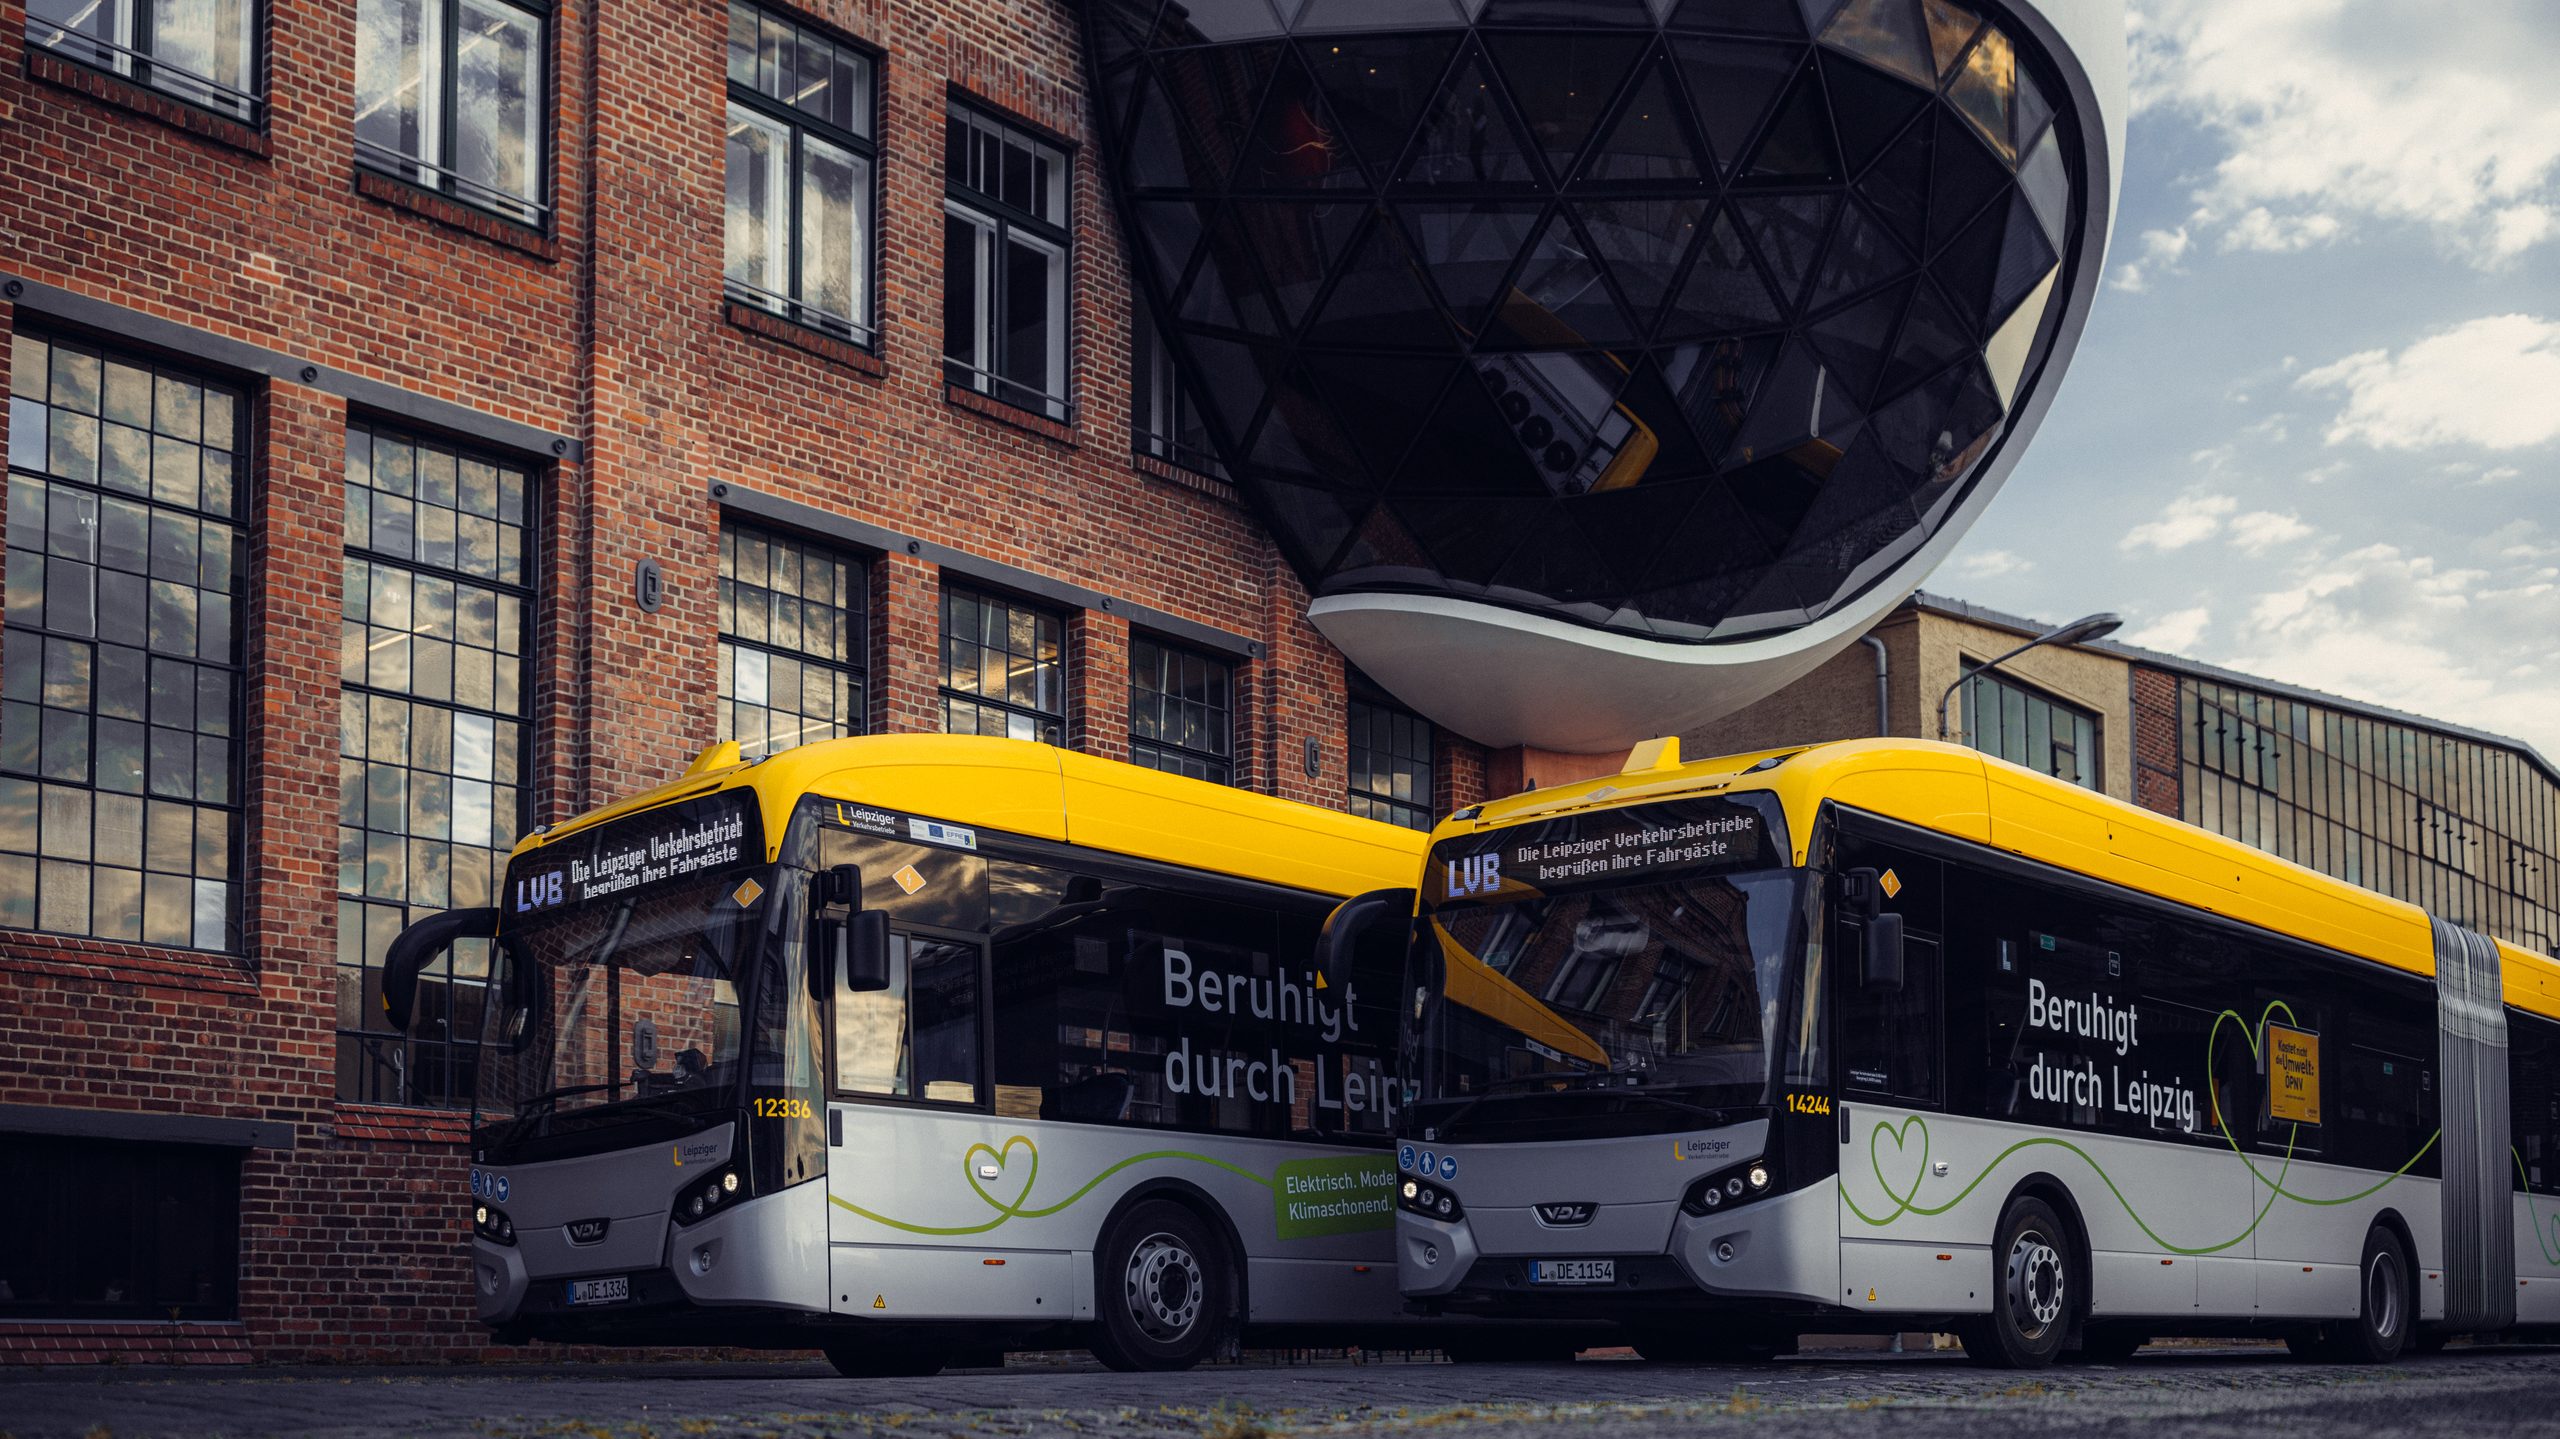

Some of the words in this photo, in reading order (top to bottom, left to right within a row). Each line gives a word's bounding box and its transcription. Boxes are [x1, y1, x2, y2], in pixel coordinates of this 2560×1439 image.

[850, 806, 895, 826] Leipziger
[852, 820, 896, 835] Verkehrsbetriebe
[1518, 846, 1540, 863] Die
[1543, 836, 1611, 859] Leipziger
[1614, 815, 1754, 848] Verkehrsbetriebe
[572, 857, 590, 883] Die
[593, 847, 647, 878] Leipziger
[1539, 857, 1608, 880] begrüßen
[1612, 853, 1641, 870] ihre
[1646, 839, 1728, 866] Fahrgäste
[583, 872, 639, 900] begrüßen
[642, 863, 667, 884] ihre
[670, 844, 738, 876] Fahrgäste
[1448, 852, 1501, 898] LVB
[517, 870, 563, 913] LVB
[2029, 978, 2138, 1056] Beruhigt
[2278, 1040, 2297, 1055] Kostet
[1165, 1036, 1296, 1104] durch
[2282, 1054, 2314, 1077] Umwelt:
[2029, 1052, 2102, 1109] durch
[2113, 1065, 2194, 1133] Leipzig
[2285, 1071, 2304, 1091] ÖPNV
[754, 1097, 812, 1119] 12336
[1786, 1093, 1830, 1116] 14244
[683, 1143, 718, 1158] Leipziger
[1687, 1139, 1731, 1153] Leipziger
[1286, 1172, 1357, 1194] Elektrisch.
[1289, 1194, 1393, 1221] Klimaschonend.
[1543, 1206, 1586, 1220] VDL
[572, 1222, 602, 1238] VDL
